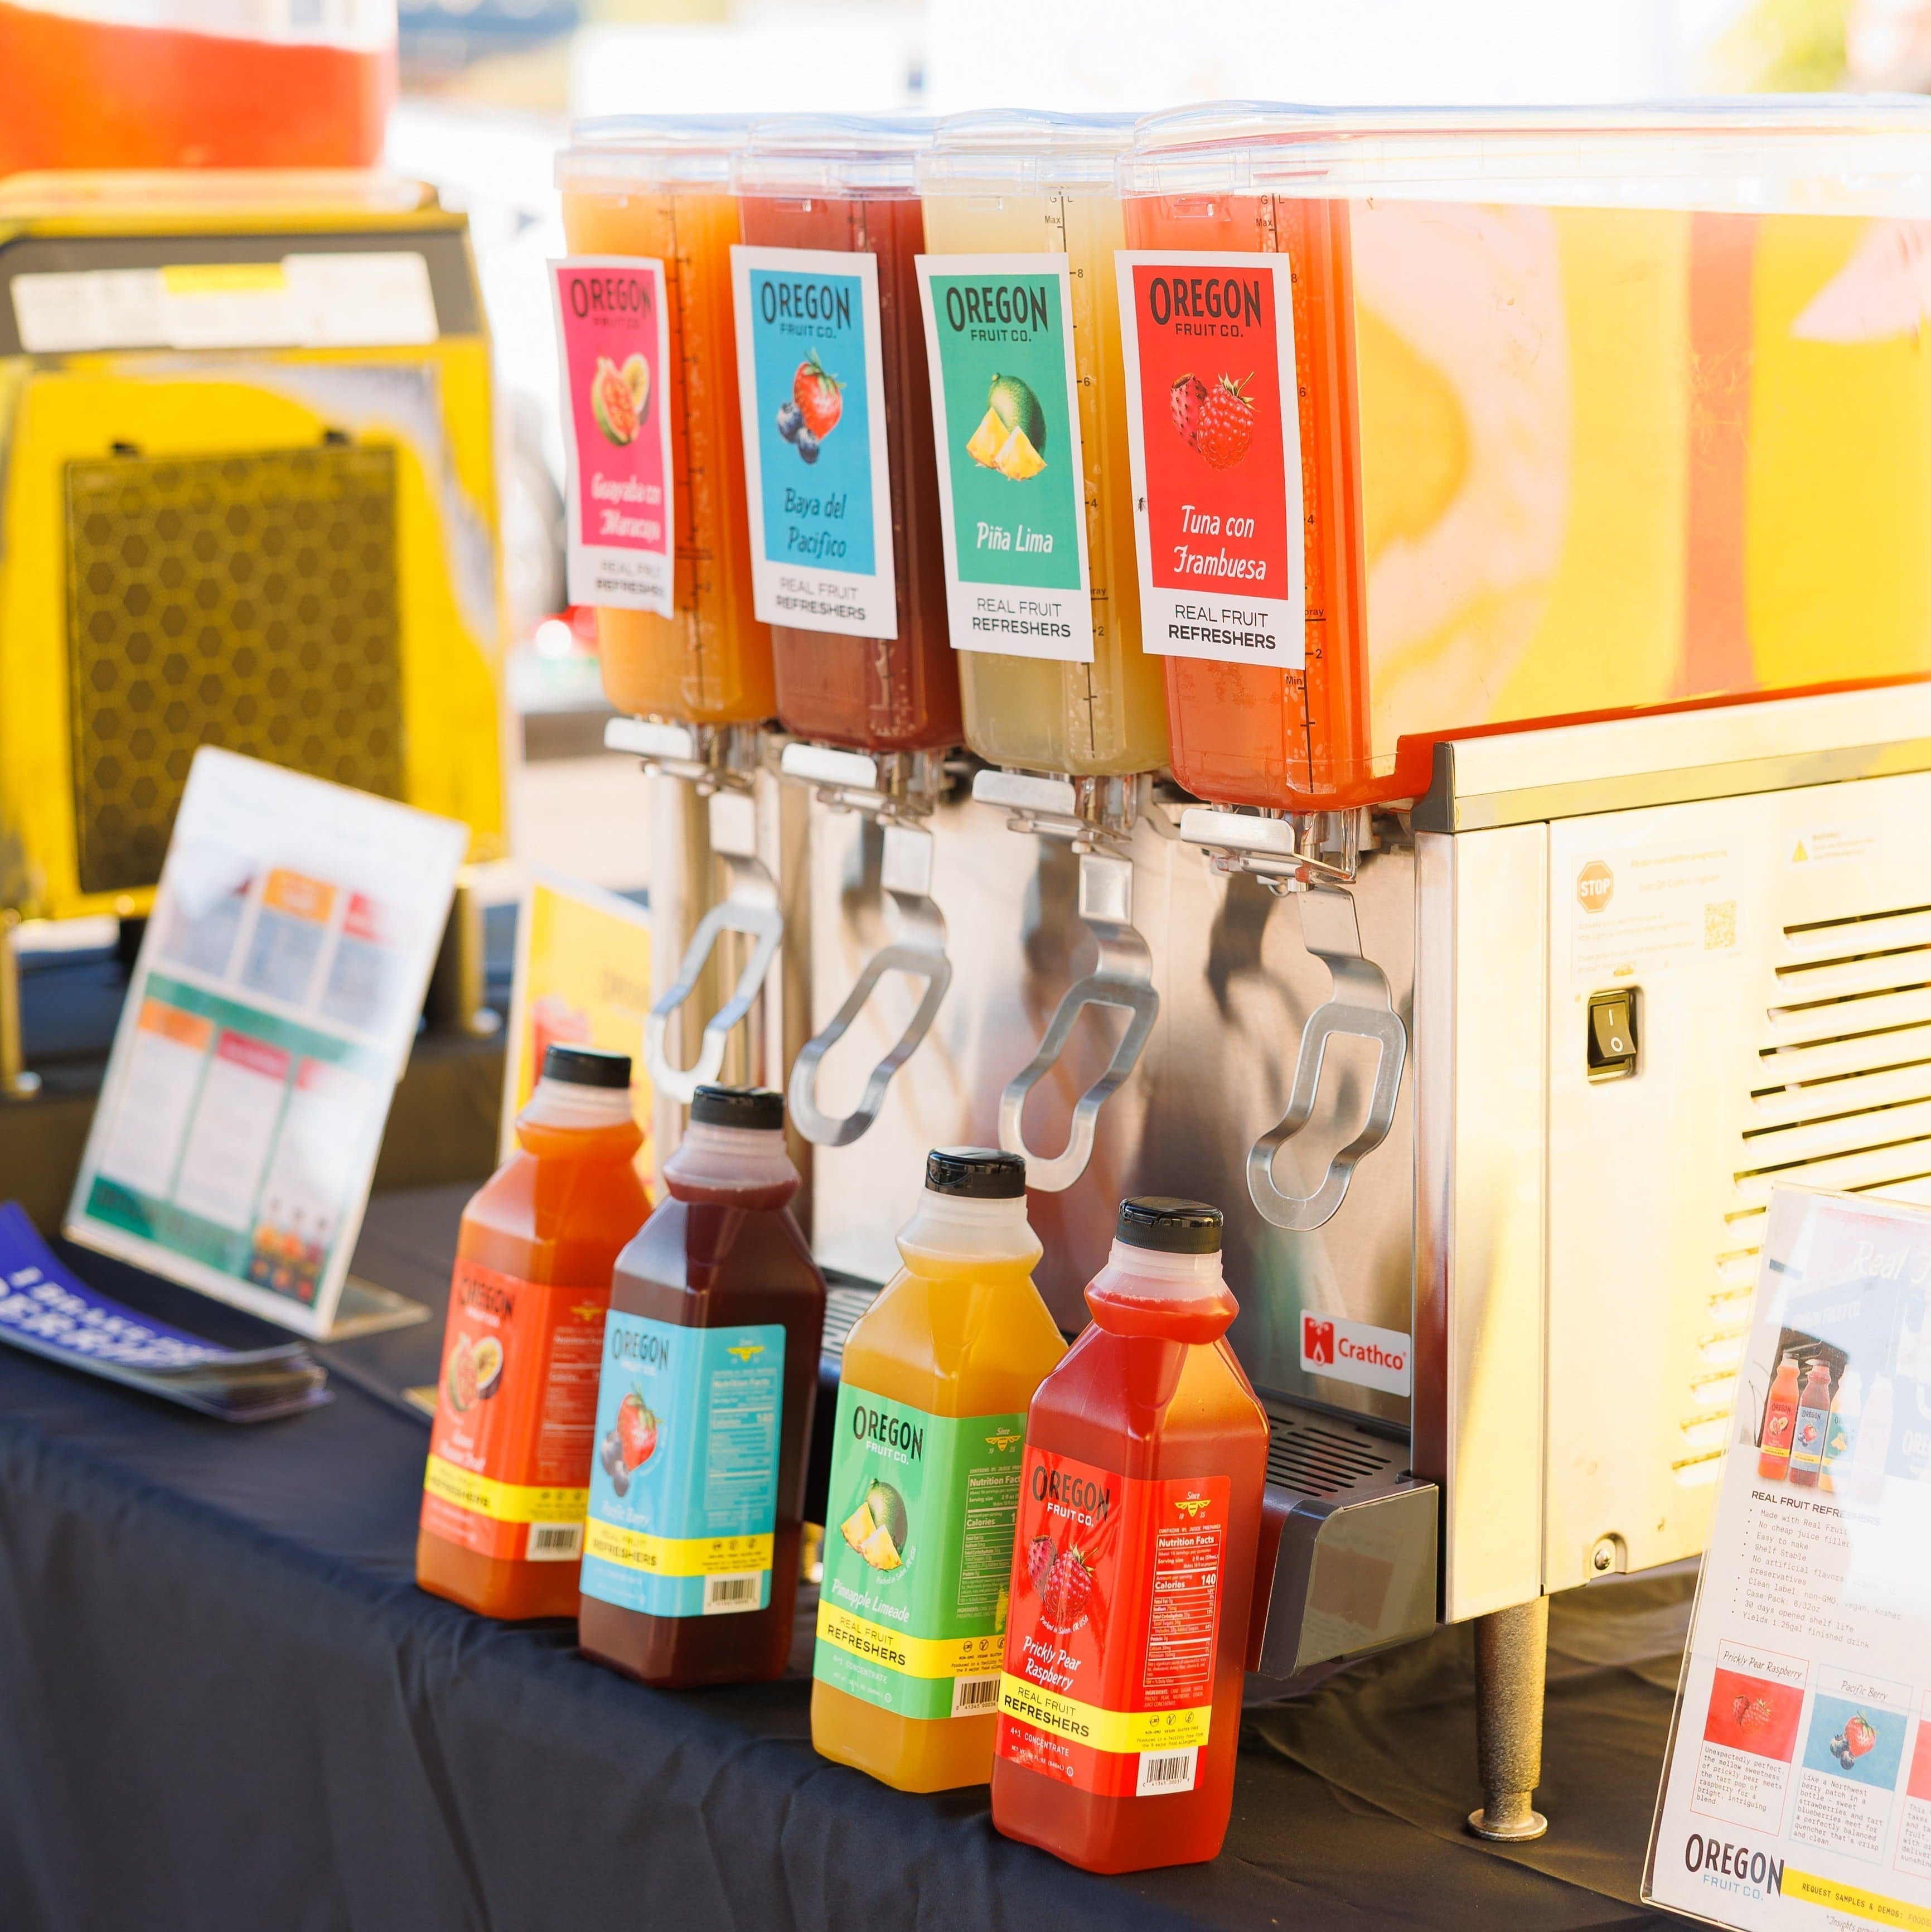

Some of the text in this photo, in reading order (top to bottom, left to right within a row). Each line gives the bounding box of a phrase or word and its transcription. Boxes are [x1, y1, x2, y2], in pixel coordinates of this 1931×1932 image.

[1044, 215, 1061, 224] Max
[1256, 218, 1272, 227] Max
[1077, 269, 1083, 278] 8
[1291, 273, 1298, 283] 8
[571, 278, 651, 320] OREGON
[762, 281, 851, 330] OREGON
[946, 284, 1048, 332] OREGON
[1150, 278, 1261, 328] OREGON
[780, 323, 814, 336] FRUIT
[971, 330, 1031, 342] FRUIT CO.
[1175, 323, 1243, 337] FRUIT CO.
[1084, 377, 1091, 387] 6
[1300, 388, 1306, 397] 6
[784, 487, 848, 519] Baya del
[1091, 499, 1097, 507] 4
[1182, 504, 1255, 538] Tuna con
[1307, 514, 1315, 525] 4
[976, 521, 1053, 553] Piña Lima
[1173, 544, 1267, 581] Frambuesa
[780, 576, 859, 600] REAL FRUIT
[776, 595, 866, 621] REFRESHERS
[977, 598, 1062, 617] REAL FRUIT
[1175, 604, 1269, 627] REAL FRUIT
[972, 617, 1071, 637] REFRESHERS
[1098, 626, 1105, 636] 2
[1168, 624, 1276, 650] REFRESHERS
[1315, 649, 1322, 659] 2
[1285, 675, 1303, 685] Min
[1580, 878, 1610, 897] STOP
[613, 1329, 669, 1371] OREGON
[1338, 1337, 1403, 1370] Crathco
[1772, 1403, 1791, 1413] OREGON
[1802, 1410, 1821, 1420] OREGON
[853, 1405, 923, 1462] OREGON
[866, 1440, 909, 1465] FRUIT CO.
[970, 1477, 1004, 1486] Nutrition
[1033, 1465, 1110, 1523] OREGON
[1187, 1491, 1201, 1500] Since
[1751, 1490, 1778, 1504] REAL
[1780, 1496, 1810, 1510] FRUIT
[966, 1518, 995, 1527] Calories
[1047, 1502, 1094, 1528] FRUIT CO.
[1760, 1509, 1778, 1519] Made
[1782, 1515, 1799, 1524] with
[1803, 1519, 1821, 1529] Real
[1159, 1536, 1214, 1547] Nutrition Facts
[1757, 1532, 1774, 1542] Easy
[1791, 1541, 1808, 1550] make
[1772, 1524, 1793, 1535] cheap
[1797, 1530, 1819, 1540] juice
[1755, 1543, 1807, 1561] Shelf Stable
[1753, 1554, 1761, 1563] No
[1766, 1558, 1808, 1574] artificial
[1155, 1573, 1216, 1589] Calories 140
[1750, 1567, 1807, 1585] preservatives
[831, 1578, 910, 1622] Pineapple Limeade
[1746, 1589, 1764, 1599] Case
[1793, 1600, 1820, 1613] 6/32oz
[1749, 1577, 1770, 1588] Clean
[1804, 1591, 1838, 1606] non-GMO,
[1845, 1601, 1870, 1614] vegan,
[1875, 1608, 1901, 1620] Kosher
[1757, 1603, 1774, 1614] days
[1779, 1609, 1806, 1621] opened
[1809, 1615, 1831, 1627] shelf
[1836, 1621, 1854, 1632] life
[840, 1616, 894, 1645] REAL FRUIT
[1743, 1611, 1869, 1648] Yields 1.25gal finished drink
[827, 1624, 906, 1665] REFRESHERS
[1023, 1635, 1082, 1671] Prickly Pear
[1025, 1658, 1073, 1691] Raspberry
[1723, 1650, 1802, 1679] Prickly Pear Raspberry
[1841, 1680, 1888, 1701] Pacific Berry
[1018, 1687, 1076, 1717] REAL FRUIT
[1005, 1694, 1090, 1737] REFRESHERS
[1010, 1727, 1069, 1757] 4+1 CONCENTRATE
[1705, 1746, 1750, 1765] Unexpectedly
[1714, 1767, 1740, 1779] prickly
[1744, 1775, 1759, 1783] pear
[1763, 1781, 1783, 1789] meets
[1716, 1775, 1731, 1784] tart
[1719, 1760, 1741, 1770] mellow
[1745, 1767, 1780, 1780] sweetness
[1700, 1779, 1733, 1793] raspberry
[1802, 1782, 1822, 1792] berry
[1825, 1789, 1846, 1798] patch
[1803, 1774, 1867, 1796] Like Northwest
[1698, 1786, 1767, 1812] bright, intriguing
[1801, 1790, 1856, 1810] bottle sweet
[1798, 1806, 1840, 1823] blueberries
[1845, 1820, 1861, 1828] meet
[1799, 1798, 1846, 1816] strawberries
[1867, 1817, 1883, 1826] tart
[1794, 1823, 1879, 1851] quencher that's crisp
[1804, 1817, 1876, 1841] perfectly balanced
[1685, 1833, 1784, 1897] OREGON
[1703, 1874, 1763, 1901] FRUIT CO.
[1802, 1883, 1832, 1898] REQUEST
[1836, 1893, 1865, 1907] SAMPLES
[1877, 1905, 1903, 1919] DEMOS:
